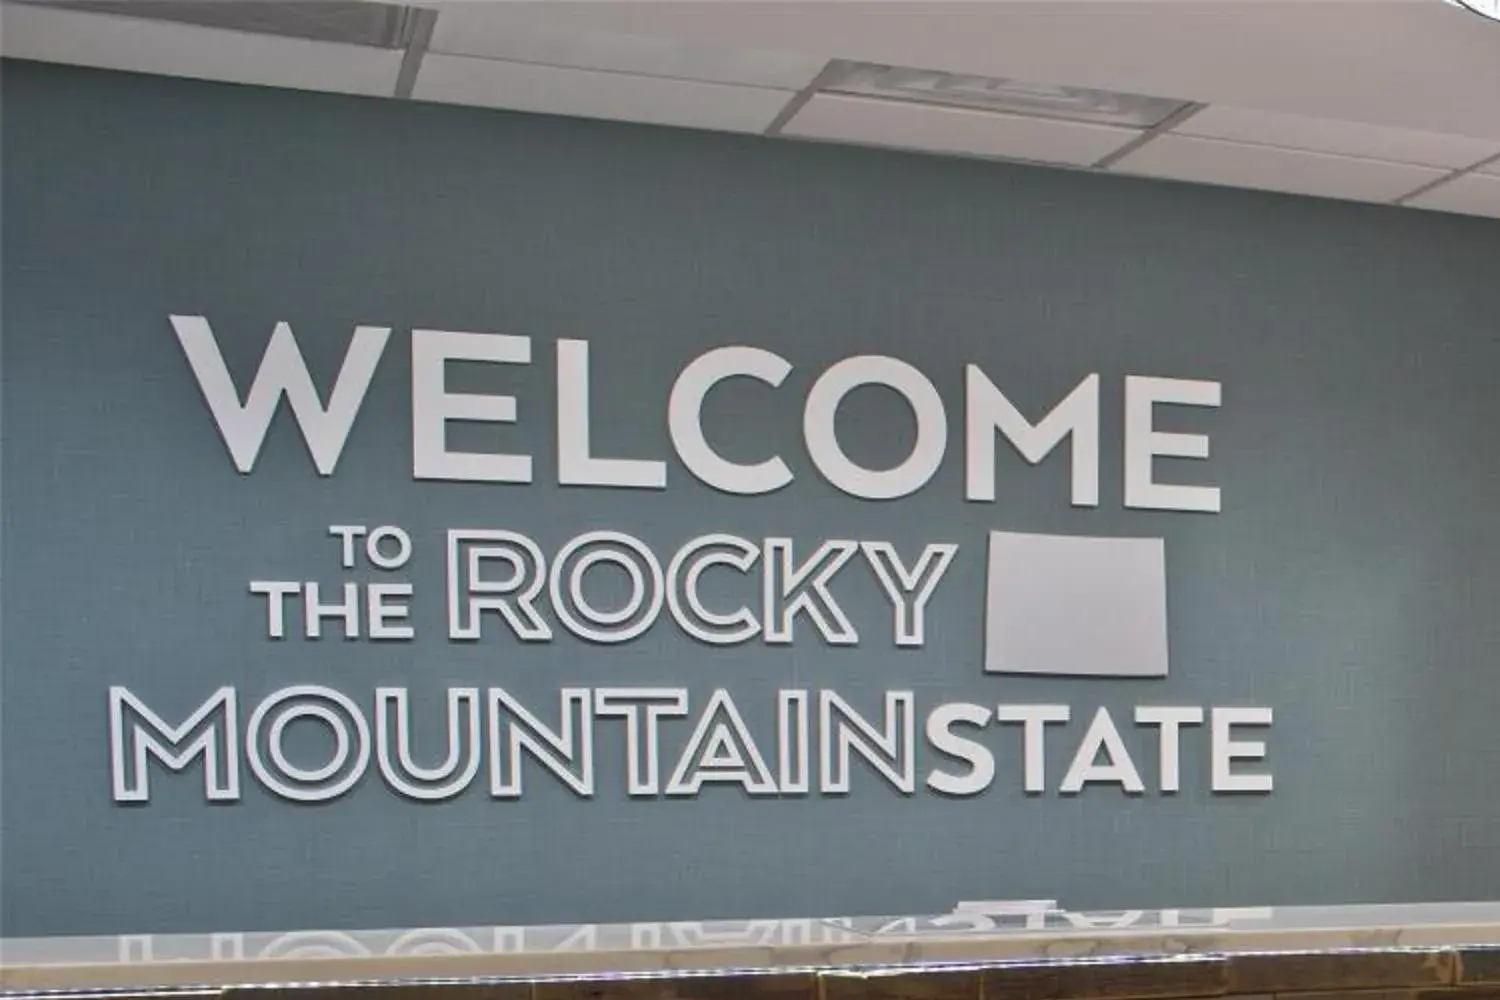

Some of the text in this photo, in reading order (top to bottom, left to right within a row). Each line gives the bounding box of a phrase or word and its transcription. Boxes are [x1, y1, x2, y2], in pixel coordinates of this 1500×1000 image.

[170, 314, 1222, 513] WELCOME
[250, 528, 958, 646] THE ROCKY
[329, 525, 412, 570] TO
